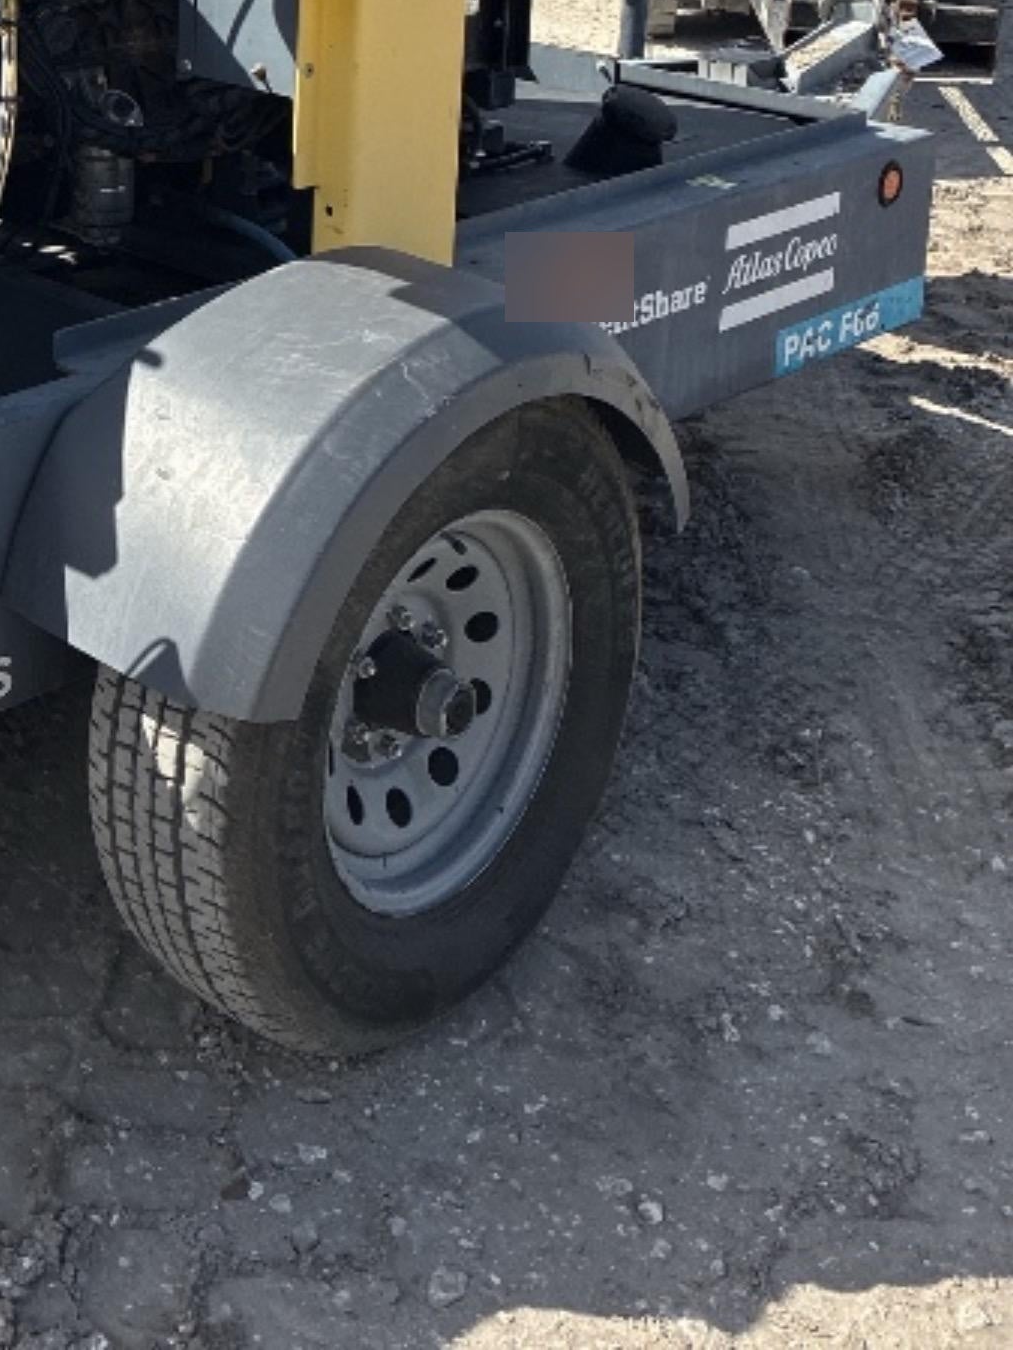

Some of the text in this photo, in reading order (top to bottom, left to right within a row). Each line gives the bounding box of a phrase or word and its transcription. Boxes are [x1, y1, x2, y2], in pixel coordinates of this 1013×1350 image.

[721, 233, 838, 295] Atlas Copco
[783, 303, 880, 367] PAC F66
